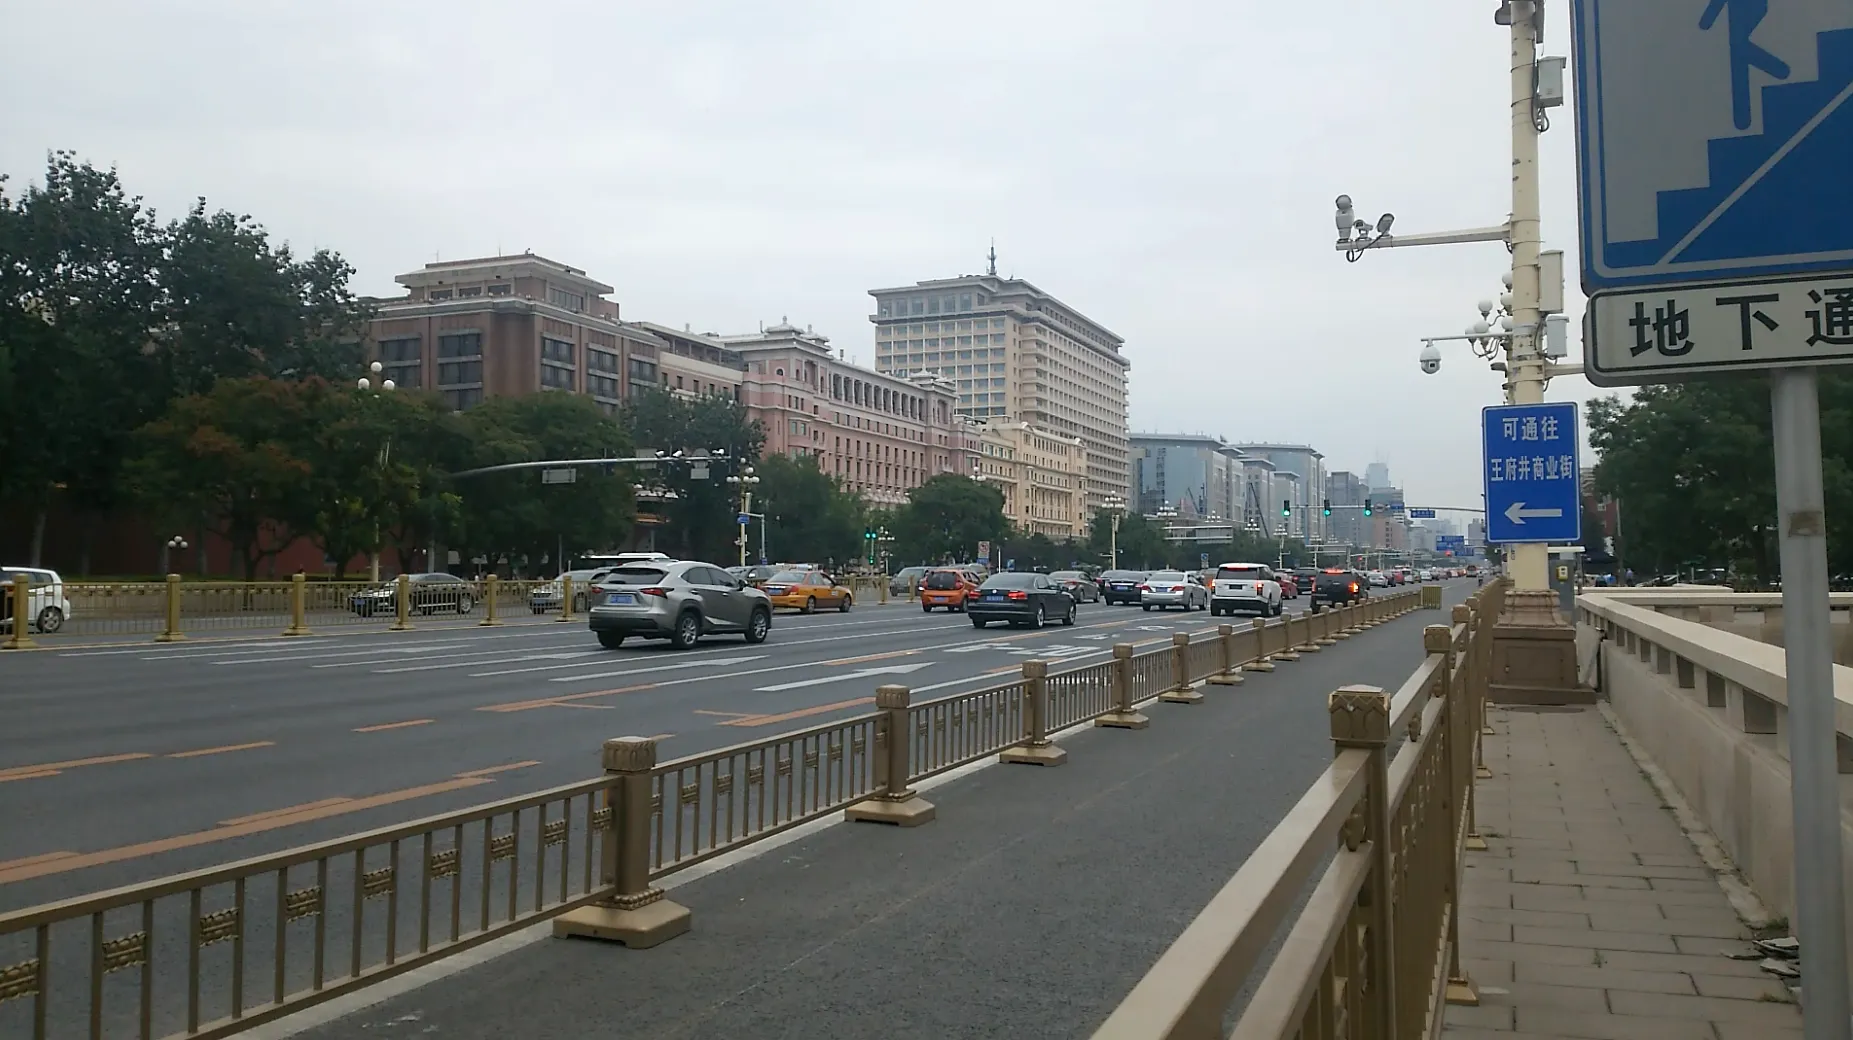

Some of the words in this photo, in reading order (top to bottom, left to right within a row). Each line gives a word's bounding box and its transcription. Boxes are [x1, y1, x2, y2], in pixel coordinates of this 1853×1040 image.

[1629, 287, 1853, 358] 地下通
[1502, 415, 1559, 442] 可通往
[1490, 455, 1573, 482] 王府井商业街
